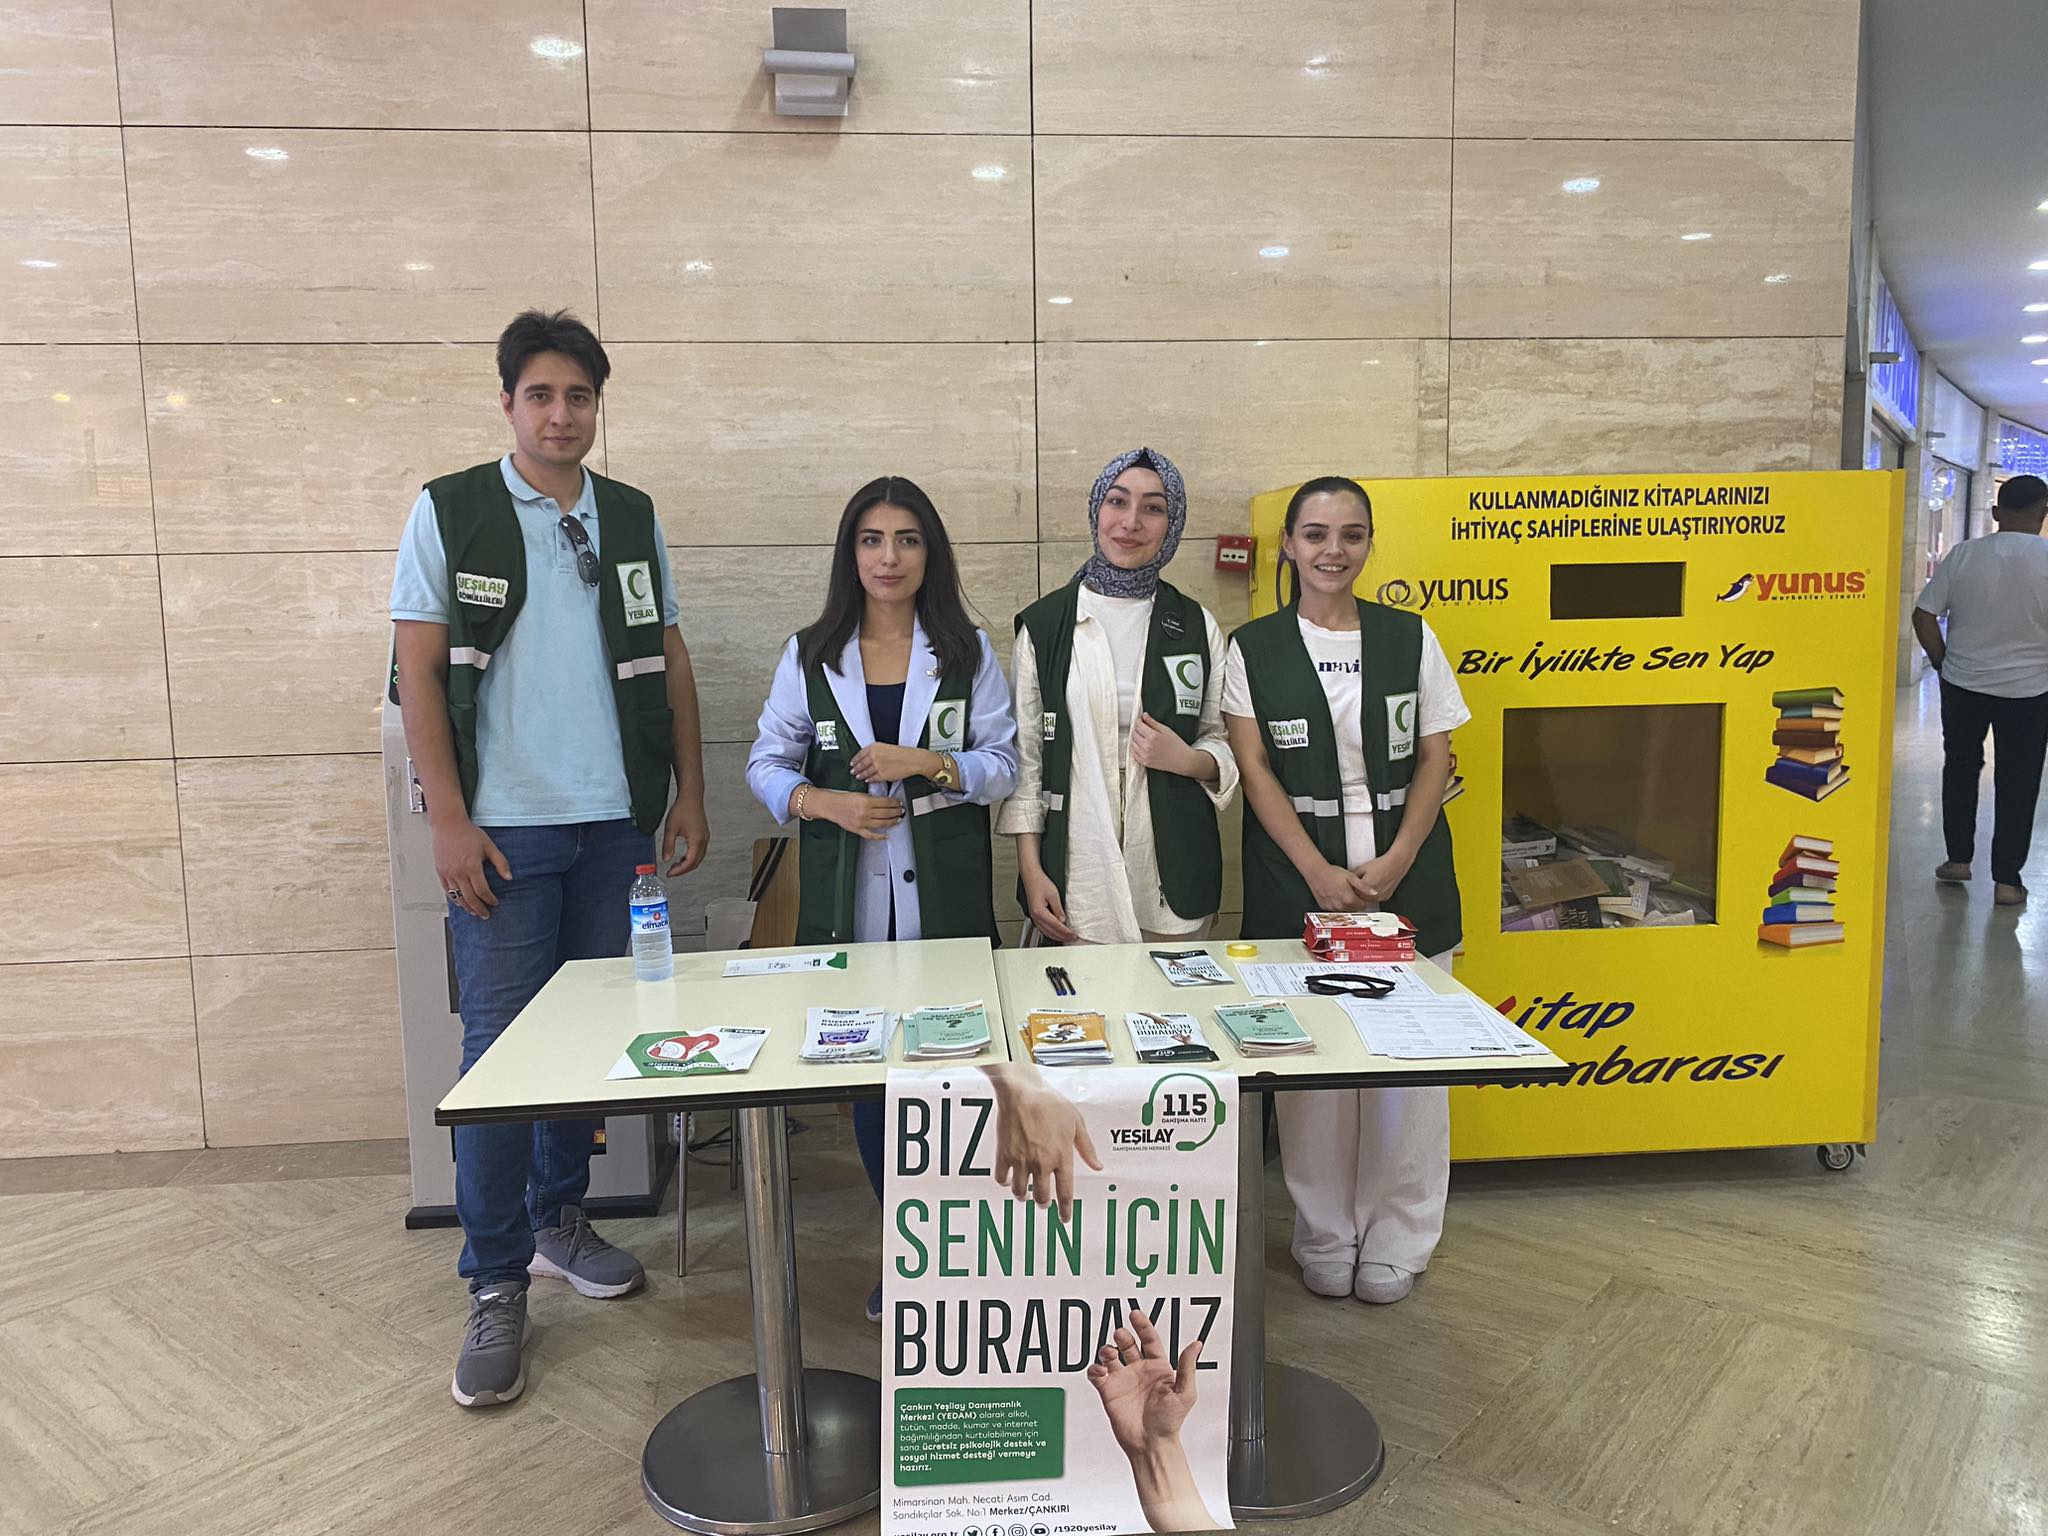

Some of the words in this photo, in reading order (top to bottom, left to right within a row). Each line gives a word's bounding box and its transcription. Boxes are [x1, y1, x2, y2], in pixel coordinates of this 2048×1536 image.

[1469, 484, 1639, 511] KULLANMADIĞINIZ
[1644, 483, 1769, 506] KİTAPLARINIZI
[1452, 516, 1522, 544] İHTİYAÇ
[1527, 512, 1642, 539] SAHİPLERİNE
[1647, 515, 1785, 540] ULAŞTIRIYORUZ
[1419, 578, 1509, 610] yunus
[1756, 571, 1865, 601] yunus
[1456, 649, 1514, 675] Bir
[1519, 641, 1635, 680] İyilikte
[1642, 646, 1709, 671] Sen
[1717, 642, 1775, 674] Yap
[1163, 1094, 1207, 1115] 115
[897, 1081, 993, 1176] BİZ
[1110, 1128, 1174, 1145] YEŞİLAY
[895, 1183, 1083, 1279] SENİN
[1105, 1183, 1225, 1289] İÇİN
[894, 1297, 1222, 1377] BURADAYIZ
[900, 1404, 932, 1413] Çankırı
[935, 1403, 966, 1411] Yeşilay
[969, 1401, 1022, 1409] Danışmanlık
[900, 1413, 934, 1421] Merkezi
[937, 1412, 977, 1421] (YEDAM)
[1008, 1410, 1030, 1418] alkol,
[1004, 1420, 1038, 1428] internet
[900, 1433, 963, 1443] bağımlılığından
[965, 1431, 1022, 1439] kurtulabilmen
[1025, 1430, 1038, 1438] için
[922, 1442, 957, 1451] ücretsiz
[960, 1441, 1001, 1450] psikolojik
[900, 1453, 927, 1463] sosyal
[930, 1452, 960, 1460] hizmet
[963, 1451, 996, 1460] desteği
[900, 1464, 932, 1472] hazırız.
[893, 1497, 945, 1506] Mimarsinan
[948, 1496, 970, 1505] Mah.
[973, 1495, 1004, 1504] Necati
[1007, 1494, 1028, 1502] Asım
[1032, 1492, 1053, 1501] Cad.
[893, 1510, 942, 1520] Sandıkçılar
[946, 1509, 964, 1517] Sok.
[990, 1505, 1070, 1516] Merkez/ÇANKIRI
[1054, 1524, 1116, 1532] /1920yesilay
